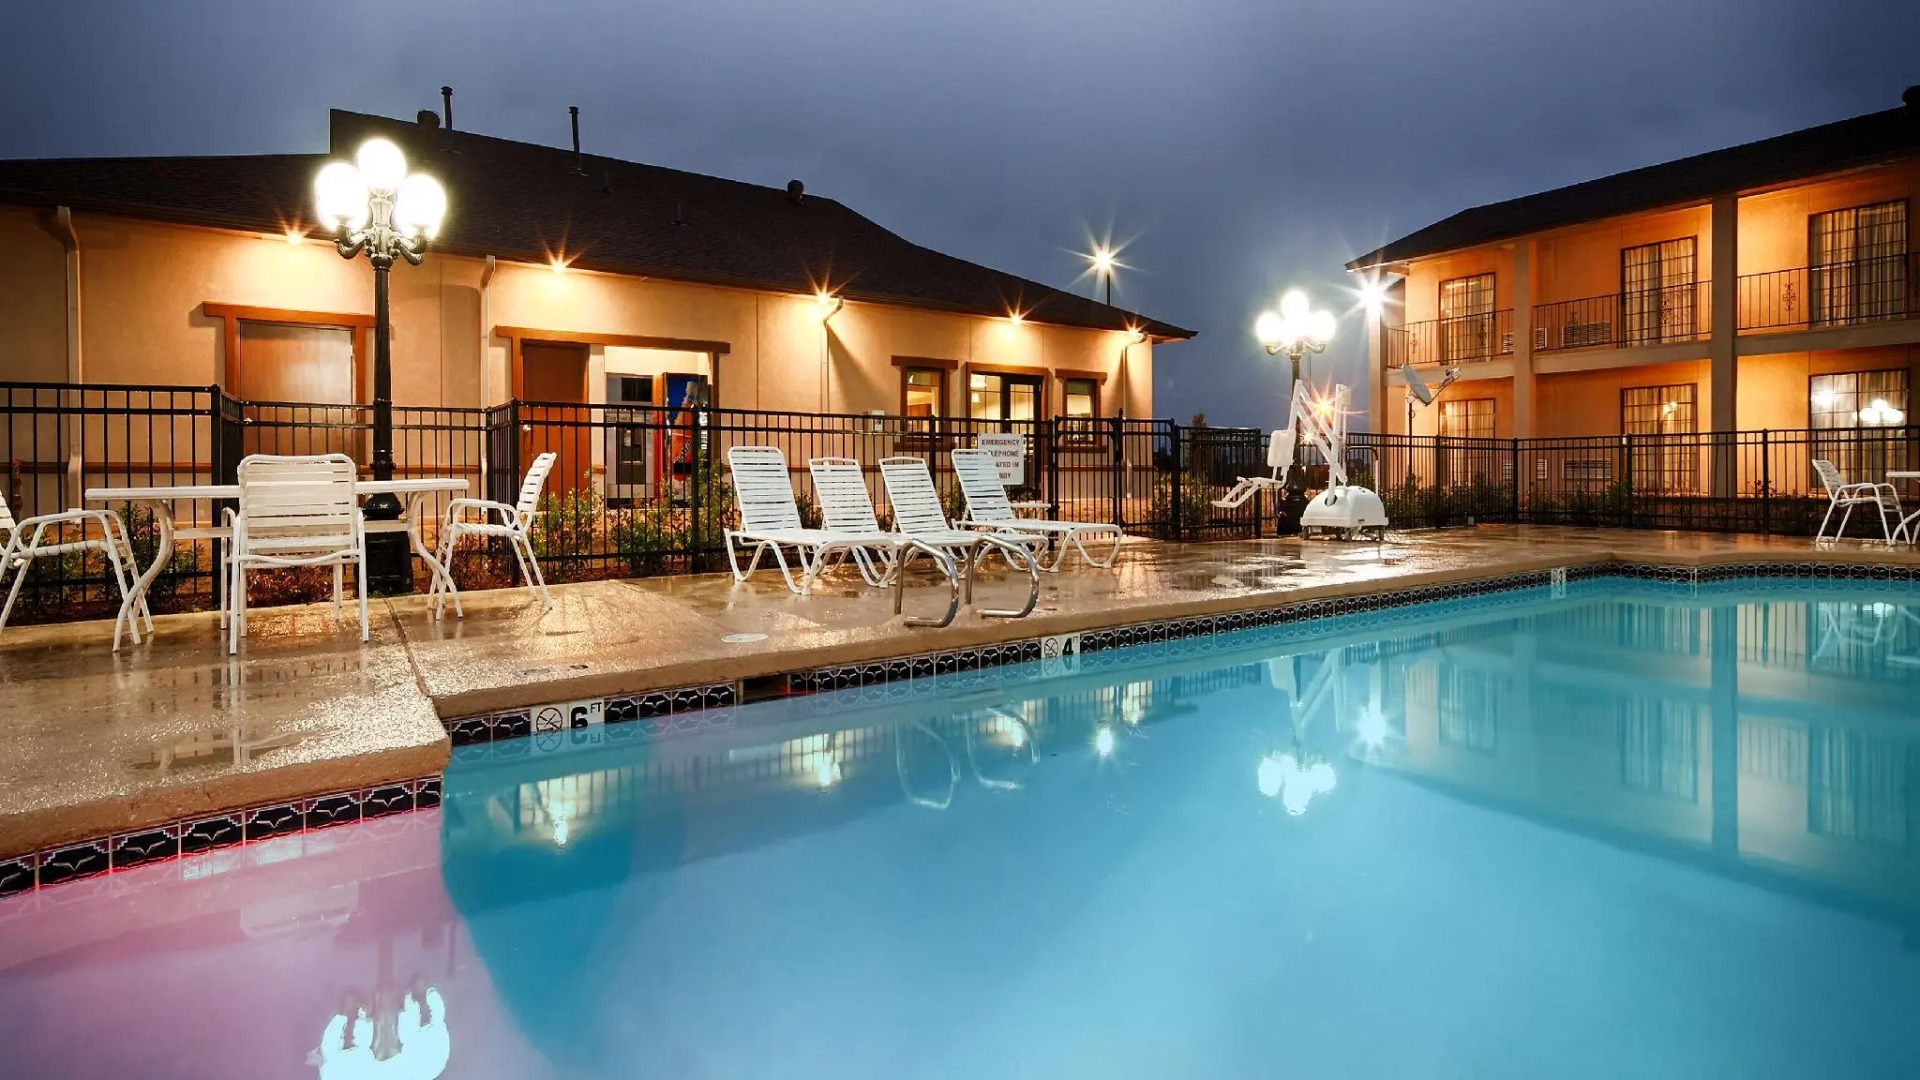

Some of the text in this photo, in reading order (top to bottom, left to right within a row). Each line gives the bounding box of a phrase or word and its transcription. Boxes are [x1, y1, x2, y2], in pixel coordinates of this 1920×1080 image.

[988, 449, 1020, 457] LEPHONE
[1062, 637, 1074, 656] 4
[570, 702, 602, 729] 6 FT
